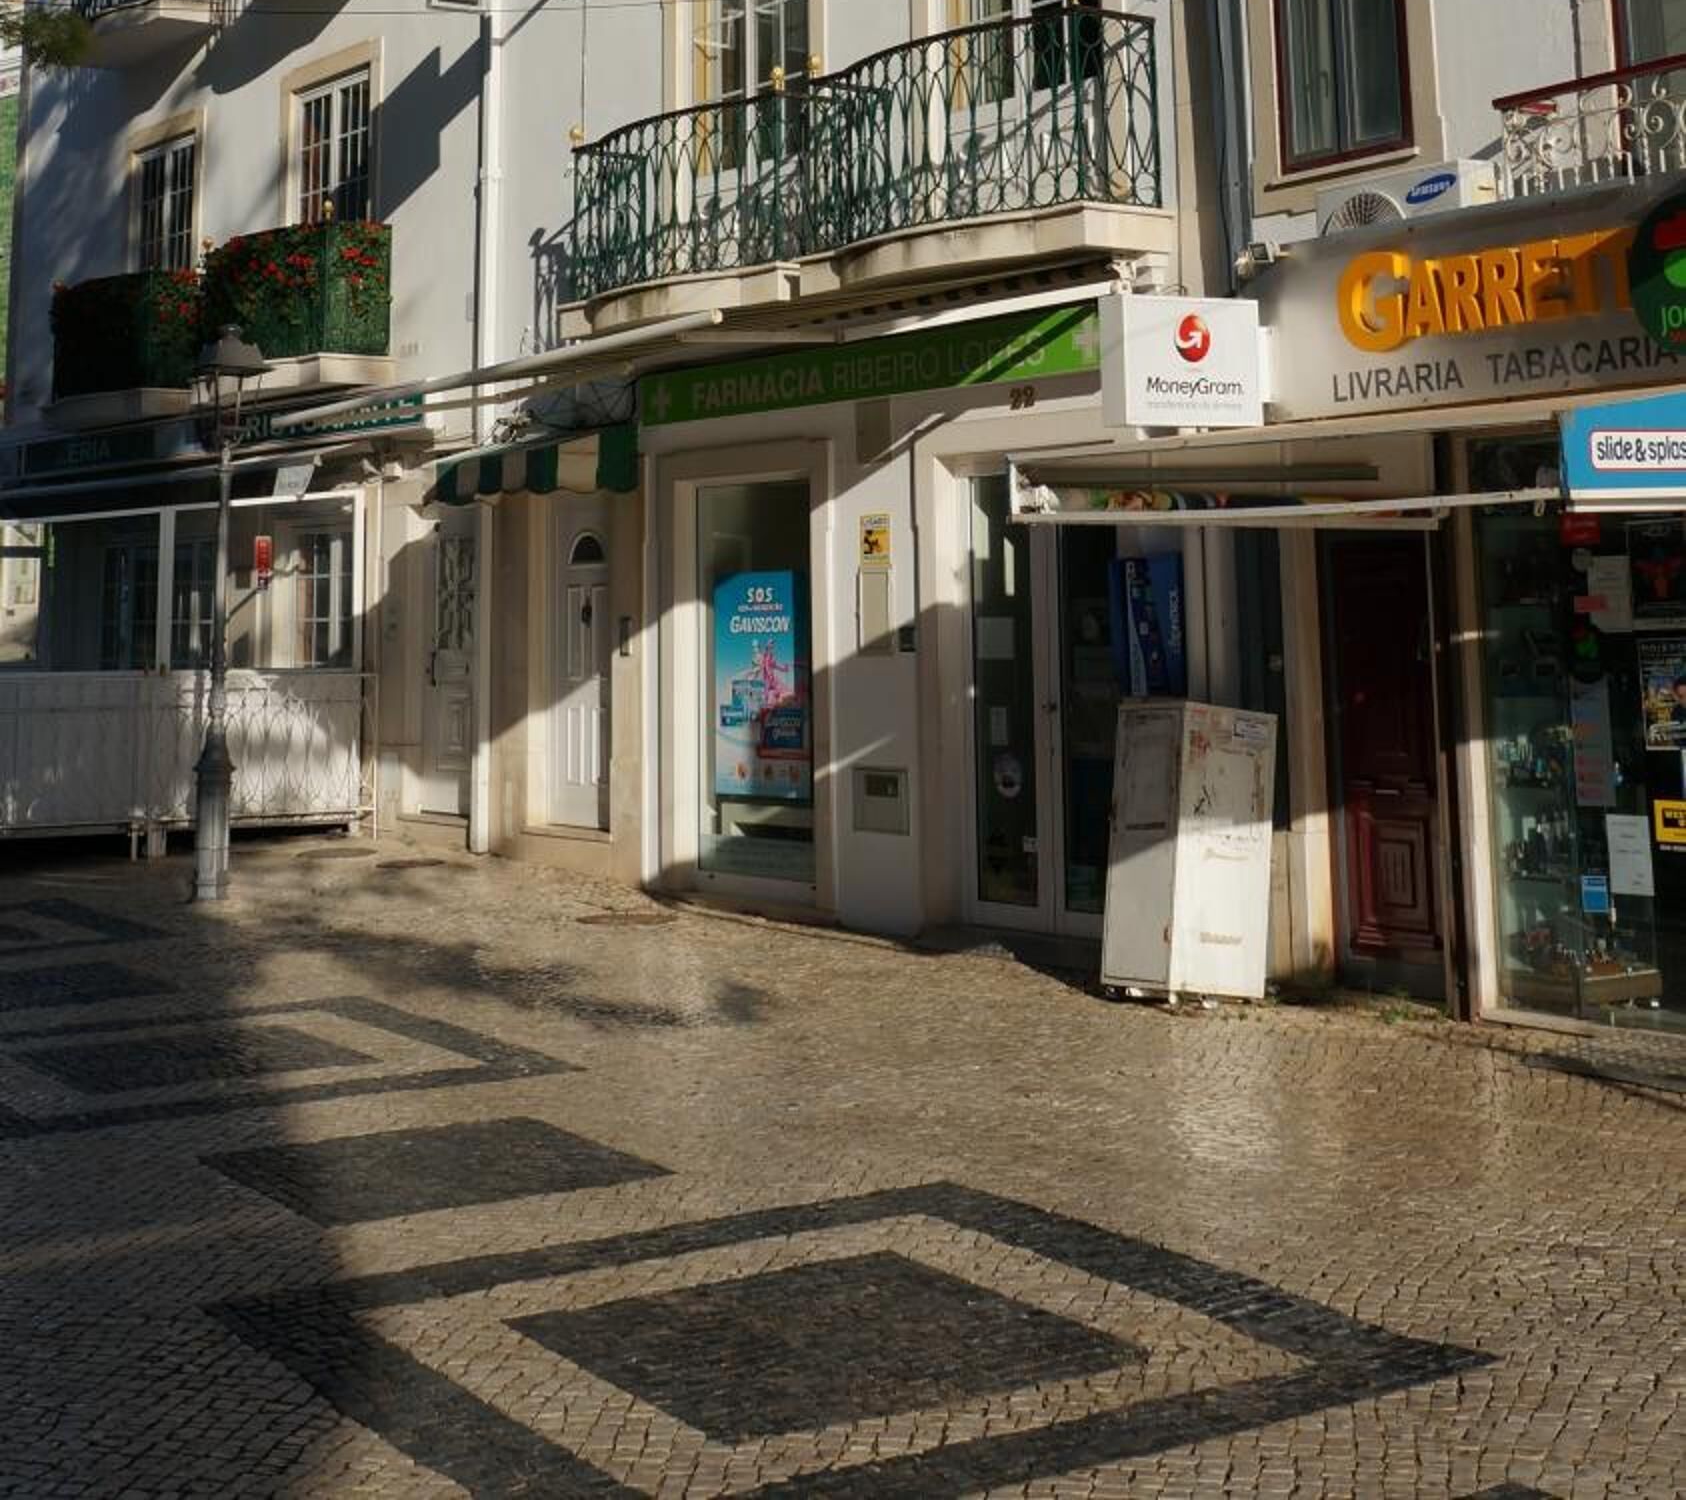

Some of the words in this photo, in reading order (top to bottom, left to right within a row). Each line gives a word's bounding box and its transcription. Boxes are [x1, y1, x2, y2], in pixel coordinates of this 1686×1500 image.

[1338, 226, 1633, 354] GARRETT
[832, 347, 940, 389] RIBEIRO
[949, 330, 1045, 376] LOPES
[1333, 357, 1464, 403] LIVRARIA
[1486, 336, 1678, 386] TABACARIA
[1146, 376, 1243, 398] MoneyGram
[747, 586, 774, 603] SOS
[730, 615, 792, 634] GAVISCON
